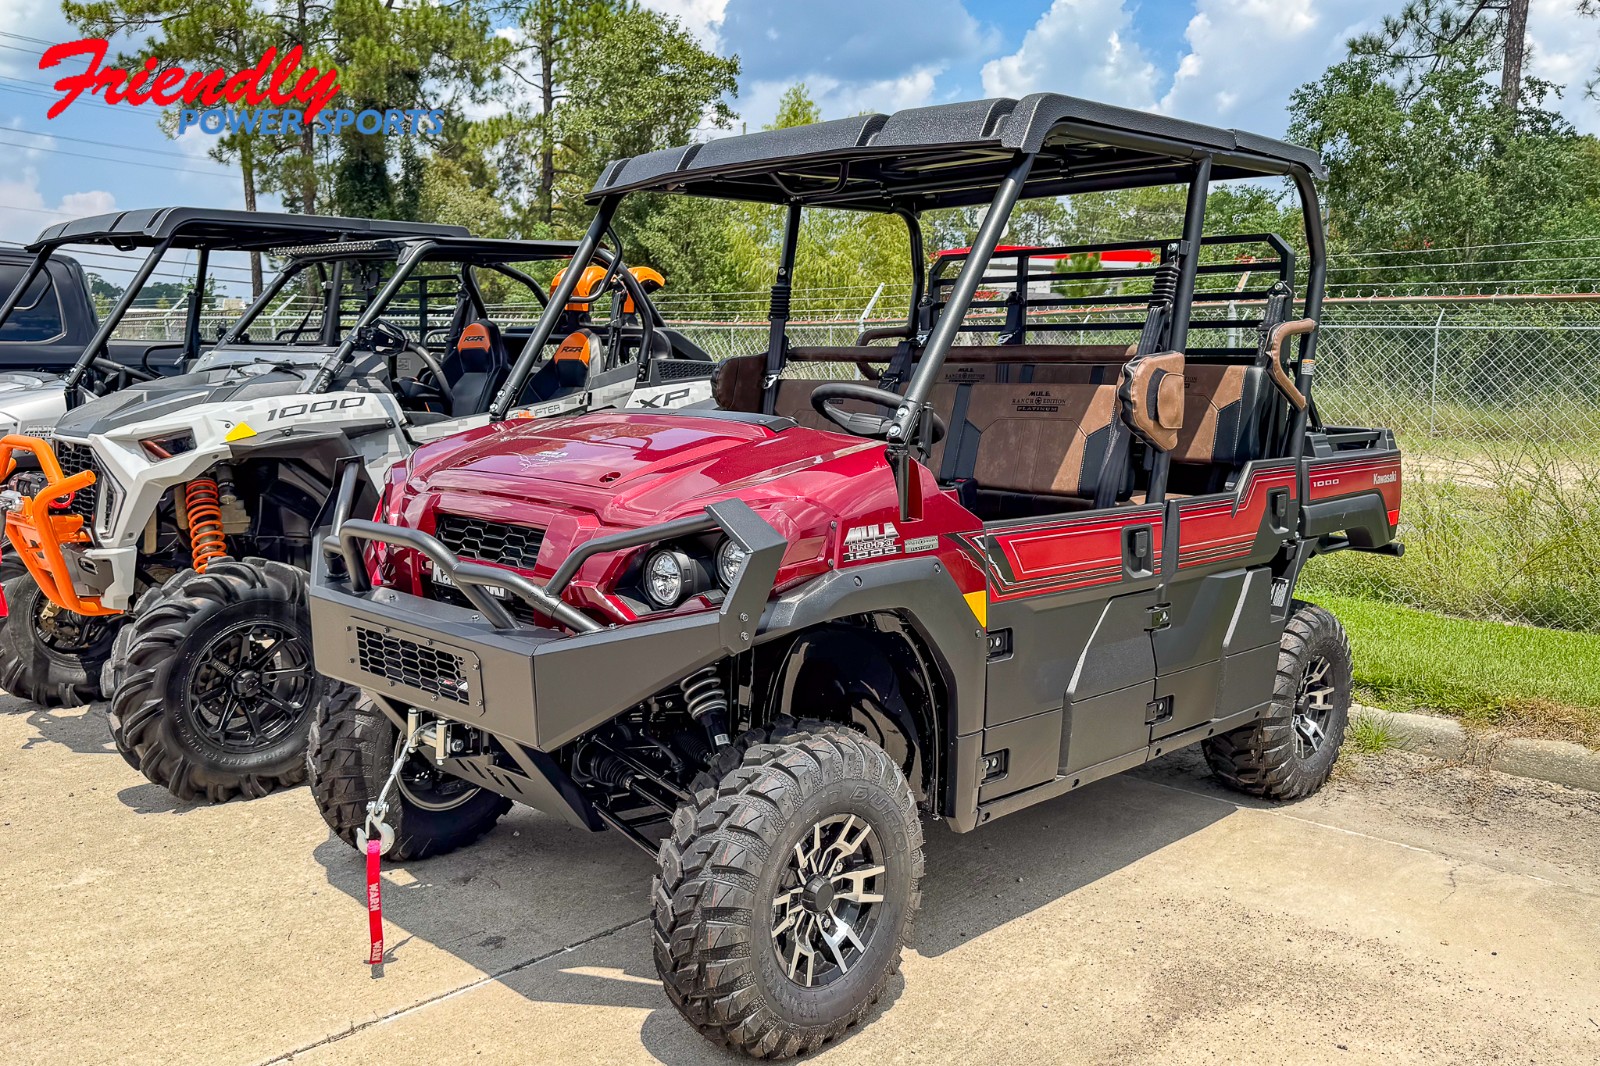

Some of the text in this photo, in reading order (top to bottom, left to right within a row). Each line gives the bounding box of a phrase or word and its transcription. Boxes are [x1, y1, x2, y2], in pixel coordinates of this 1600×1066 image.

[267, 396, 366, 422] 1000
[634, 388, 690, 409] XP
[1313, 479, 1340, 488] 1000
[1373, 471, 1397, 485] Kawasaki
[843, 522, 900, 546] MULE
[369, 883, 380, 912] WARN
